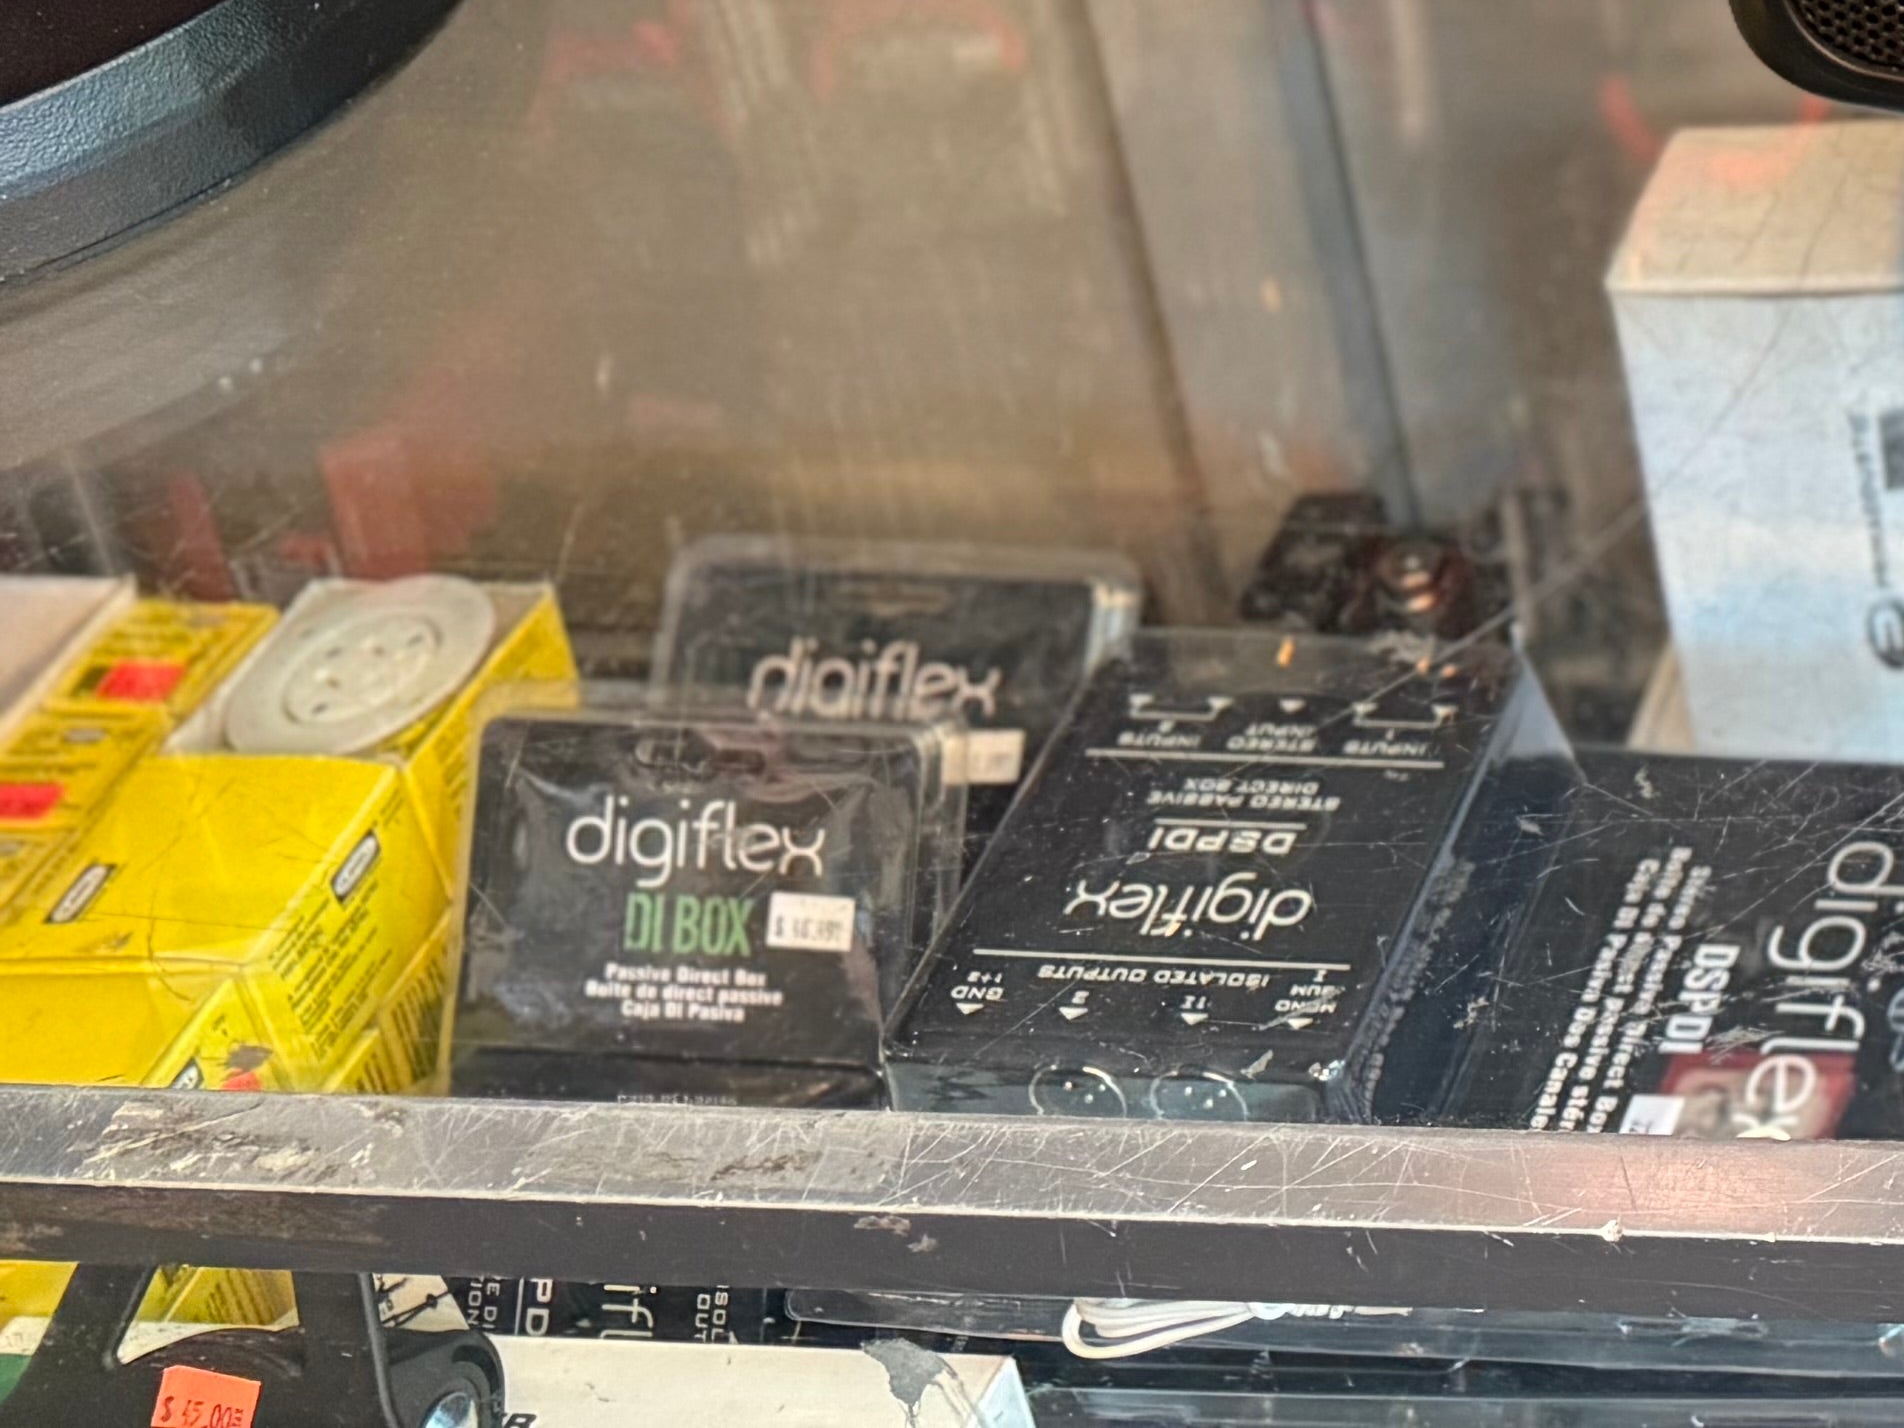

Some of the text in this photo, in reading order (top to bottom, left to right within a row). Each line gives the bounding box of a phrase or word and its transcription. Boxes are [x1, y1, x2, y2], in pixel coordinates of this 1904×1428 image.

[565, 794, 825, 889] digiflex
[1145, 827, 1298, 856] DSPDI
[1062, 871, 1314, 941] digiflex
[623, 892, 753, 957] DI BOX
[605, 962, 672, 982] Passive
[676, 964, 731, 985] Direct
[1036, 964, 1271, 988] ISOLATED OUTPUTS
[662, 985, 714, 1003] direct
[717, 988, 783, 1006] passive
[950, 985, 1003, 1000] GND
[1657, 942, 1741, 1055] DSPDI
[688, 1003, 745, 1022] Pasiva
